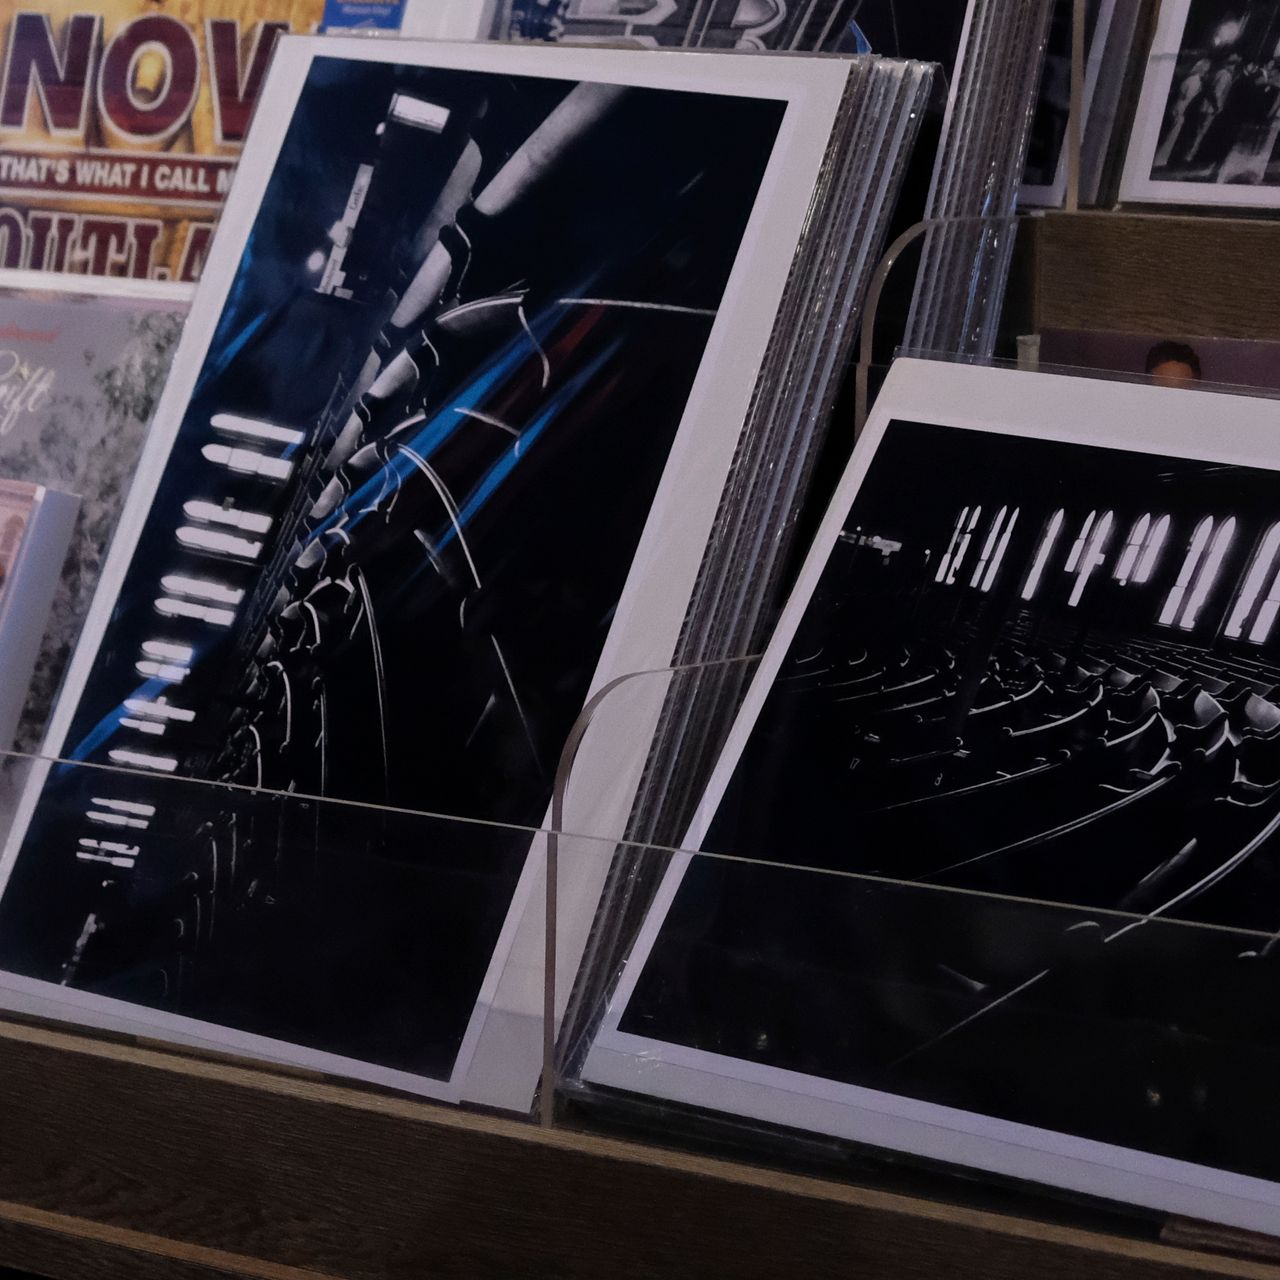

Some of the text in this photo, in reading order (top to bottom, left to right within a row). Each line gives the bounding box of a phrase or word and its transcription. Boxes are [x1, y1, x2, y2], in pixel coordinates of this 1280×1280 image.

[0, 154, 69, 184] THAT'S
[75, 158, 136, 188] WHAT
[140, 163, 149, 189] I
[154, 164, 209, 194] CALL
